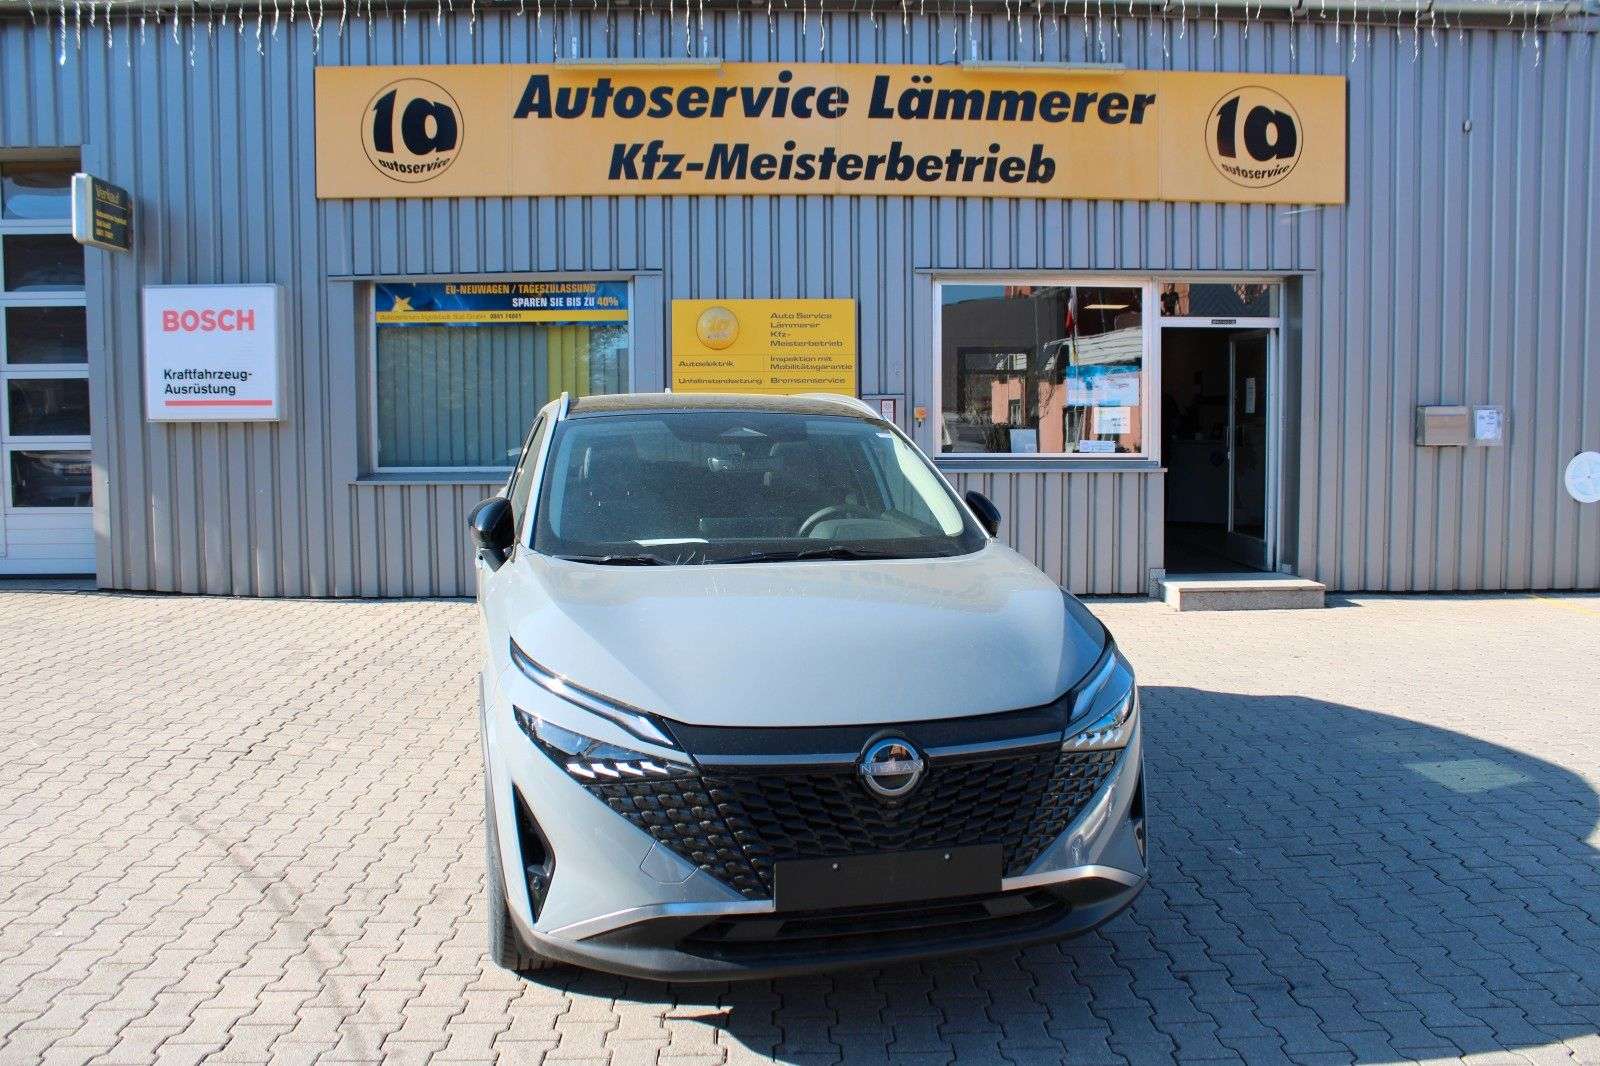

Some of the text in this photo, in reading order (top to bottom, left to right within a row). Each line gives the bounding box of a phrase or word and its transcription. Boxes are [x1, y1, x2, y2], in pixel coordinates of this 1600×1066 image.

[513, 70, 1156, 125] Autoservice Lämmerer
[372, 88, 458, 156] 1a
[1216, 95, 1297, 162] 1a
[378, 157, 451, 174] autoservice
[608, 140, 1056, 184] Kfz-Meisterbetrieb
[1221, 164, 1290, 179] autoservice
[445, 284, 510, 295] EU-NEUWAGEN
[519, 283, 596, 294] TAGESZULASSUNG
[512, 296, 619, 308] SPAREN SIE BIS ZU 40%
[162, 309, 255, 332] BOSCH
[163, 368, 254, 382] Kraftfahrzeug-
[164, 382, 237, 396] Ausrüstung
